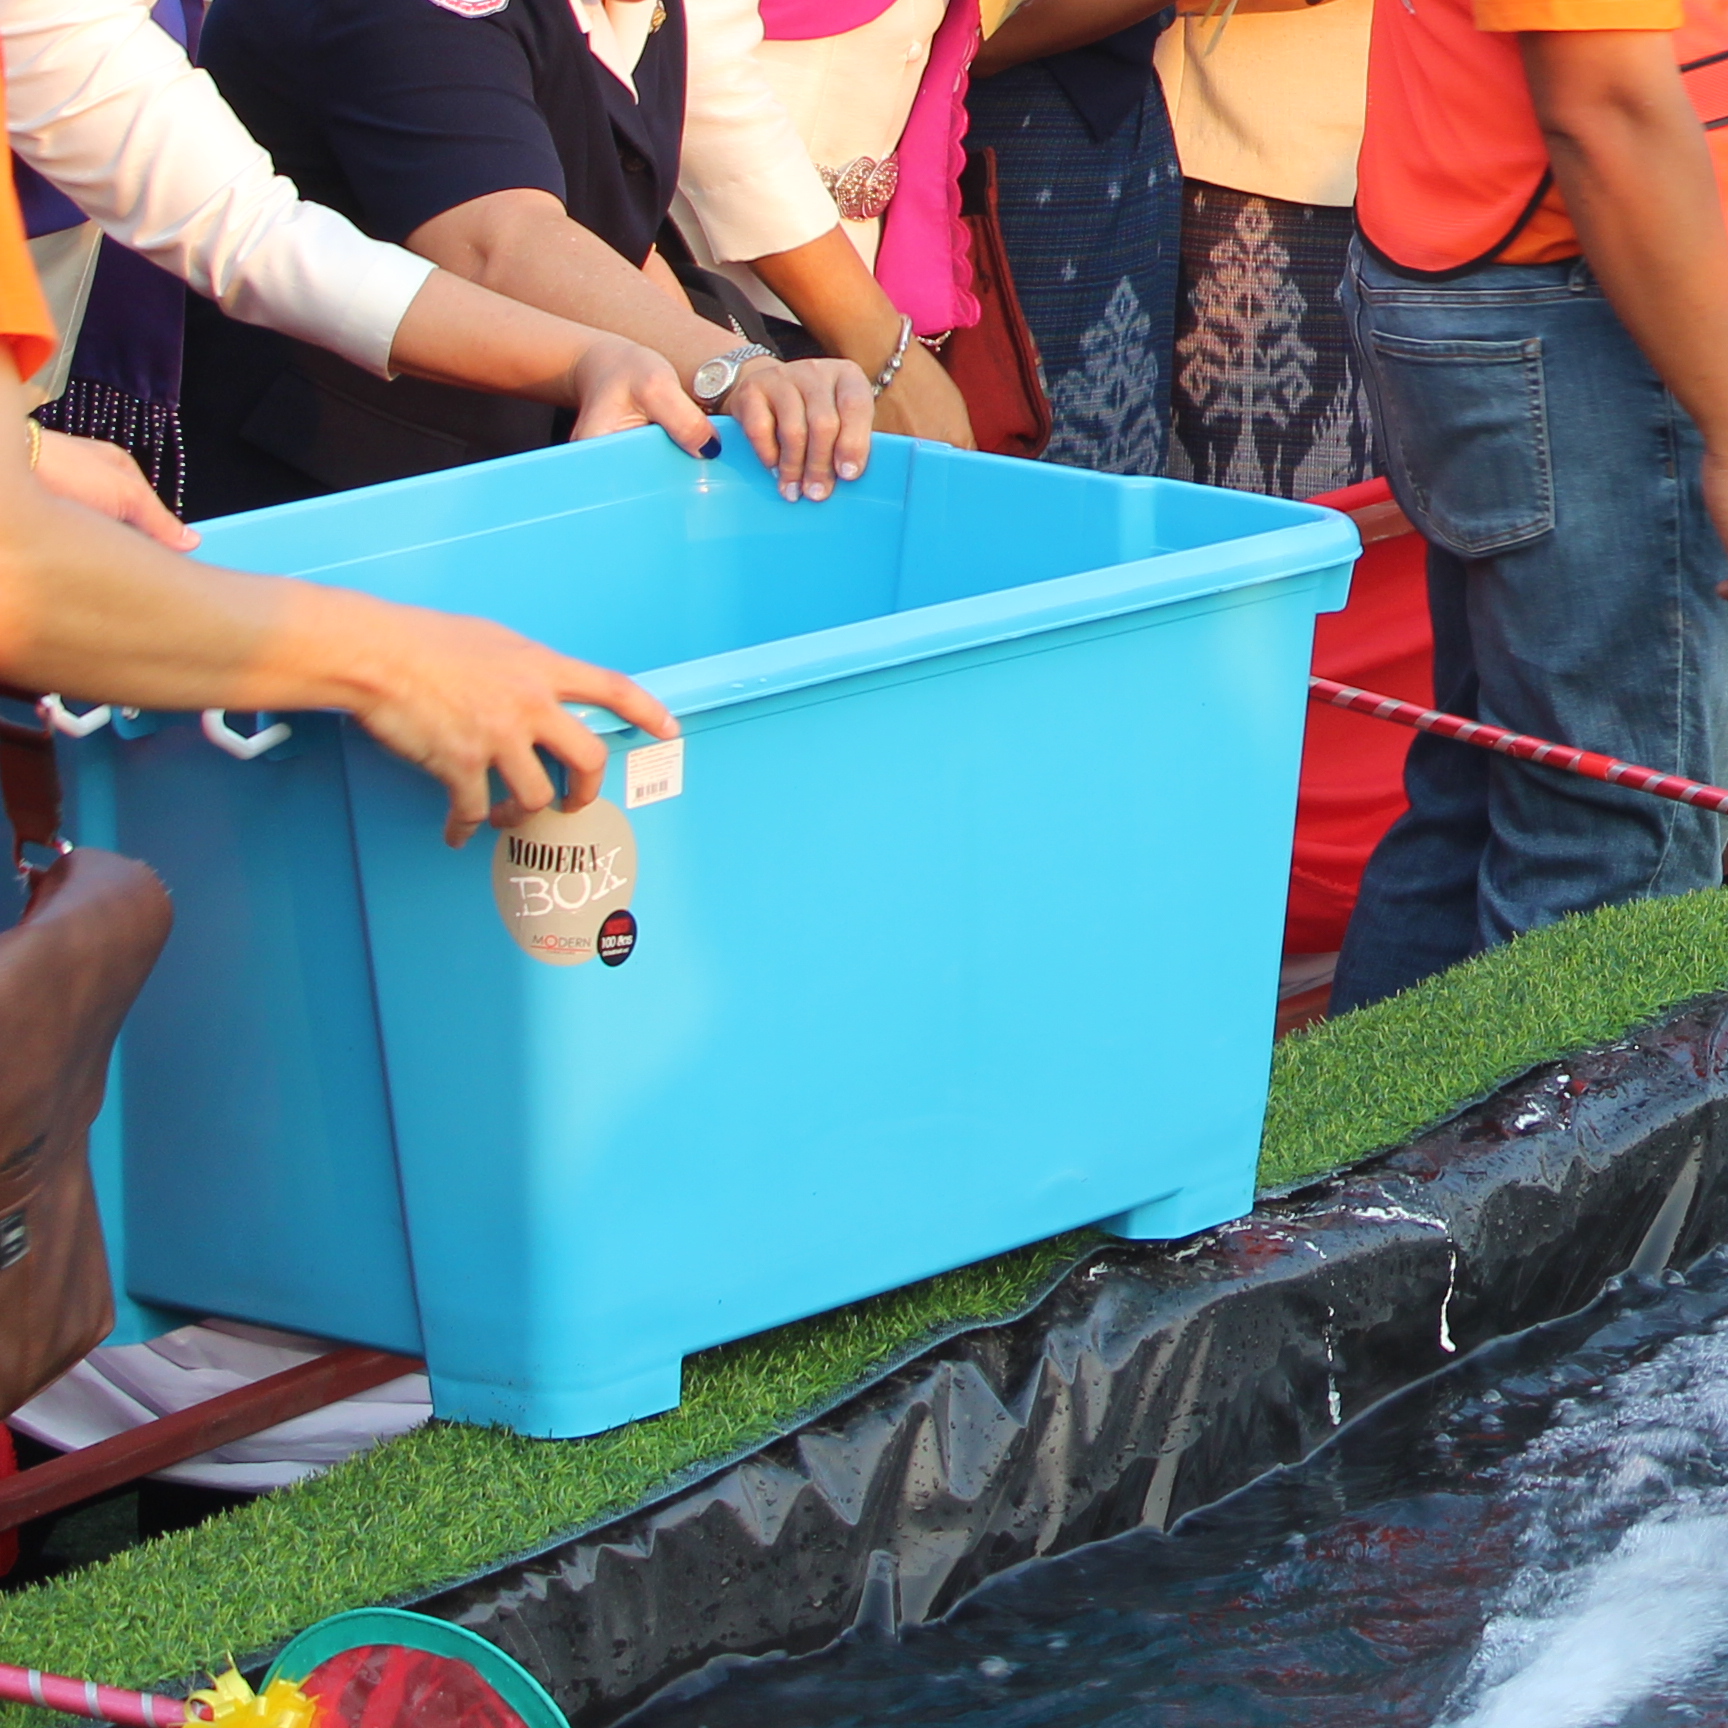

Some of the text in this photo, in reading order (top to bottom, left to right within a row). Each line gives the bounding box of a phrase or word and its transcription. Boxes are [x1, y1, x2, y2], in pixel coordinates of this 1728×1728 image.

[507, 835, 601, 874] MODERN
[509, 846, 628, 918] BOX
[531, 934, 592, 949] MODERN
